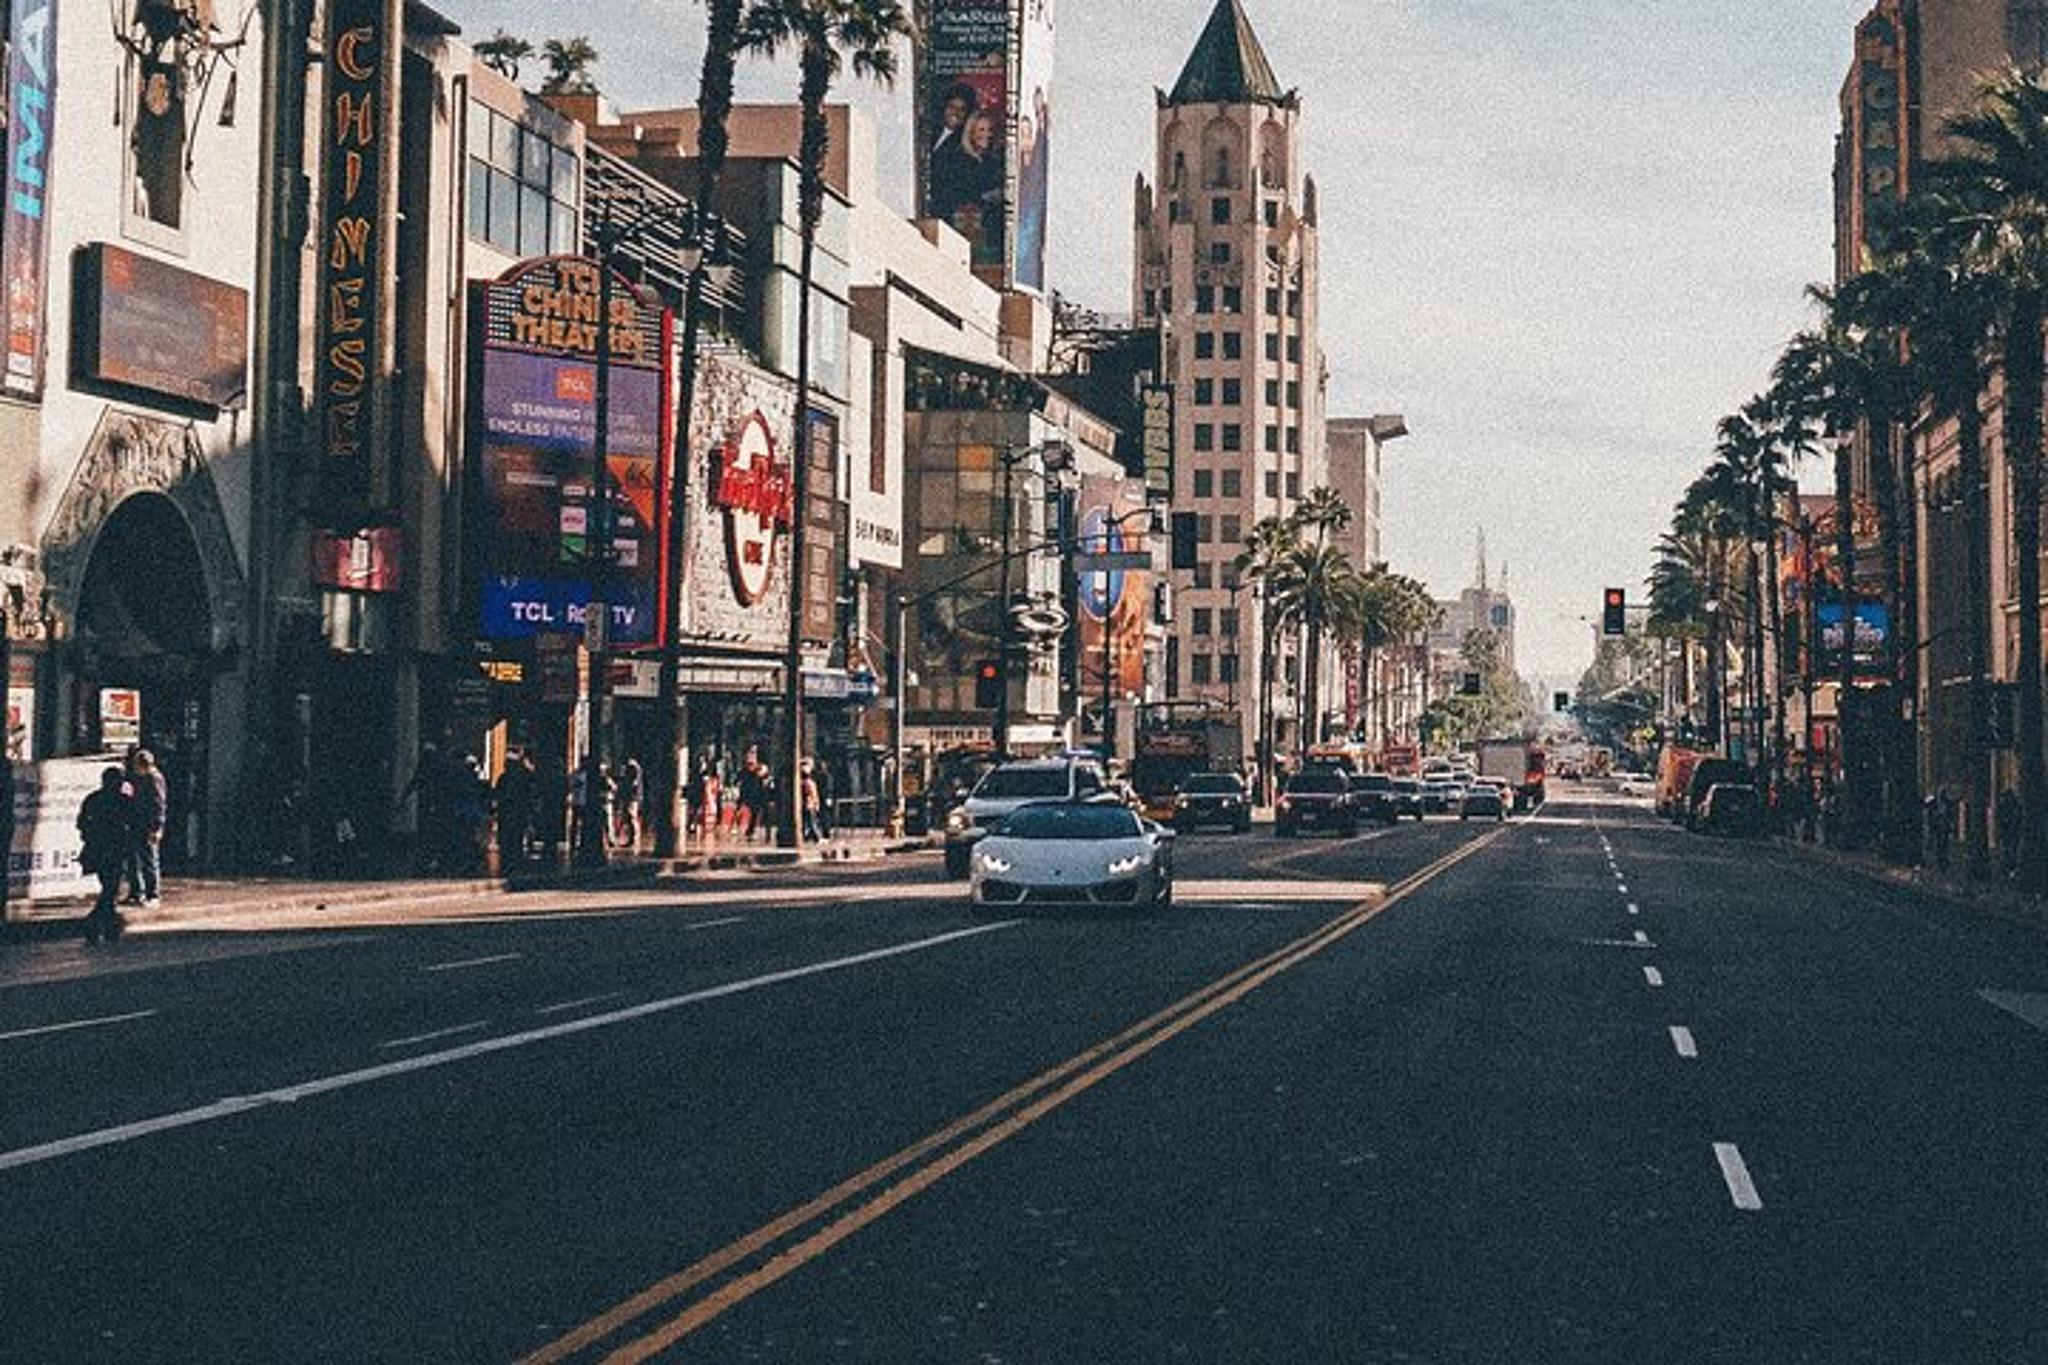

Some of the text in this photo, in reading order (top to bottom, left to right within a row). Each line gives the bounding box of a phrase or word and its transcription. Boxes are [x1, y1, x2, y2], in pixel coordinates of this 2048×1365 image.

[329, 27, 373, 456] CHINESE
[522, 285, 638, 326] CHINSE
[562, 378, 589, 392] TCL
[511, 402, 581, 422] STUNNING
[487, 418, 550, 437] ENDLESS
[511, 601, 556, 622] TCL
[611, 605, 636, 625] TV
